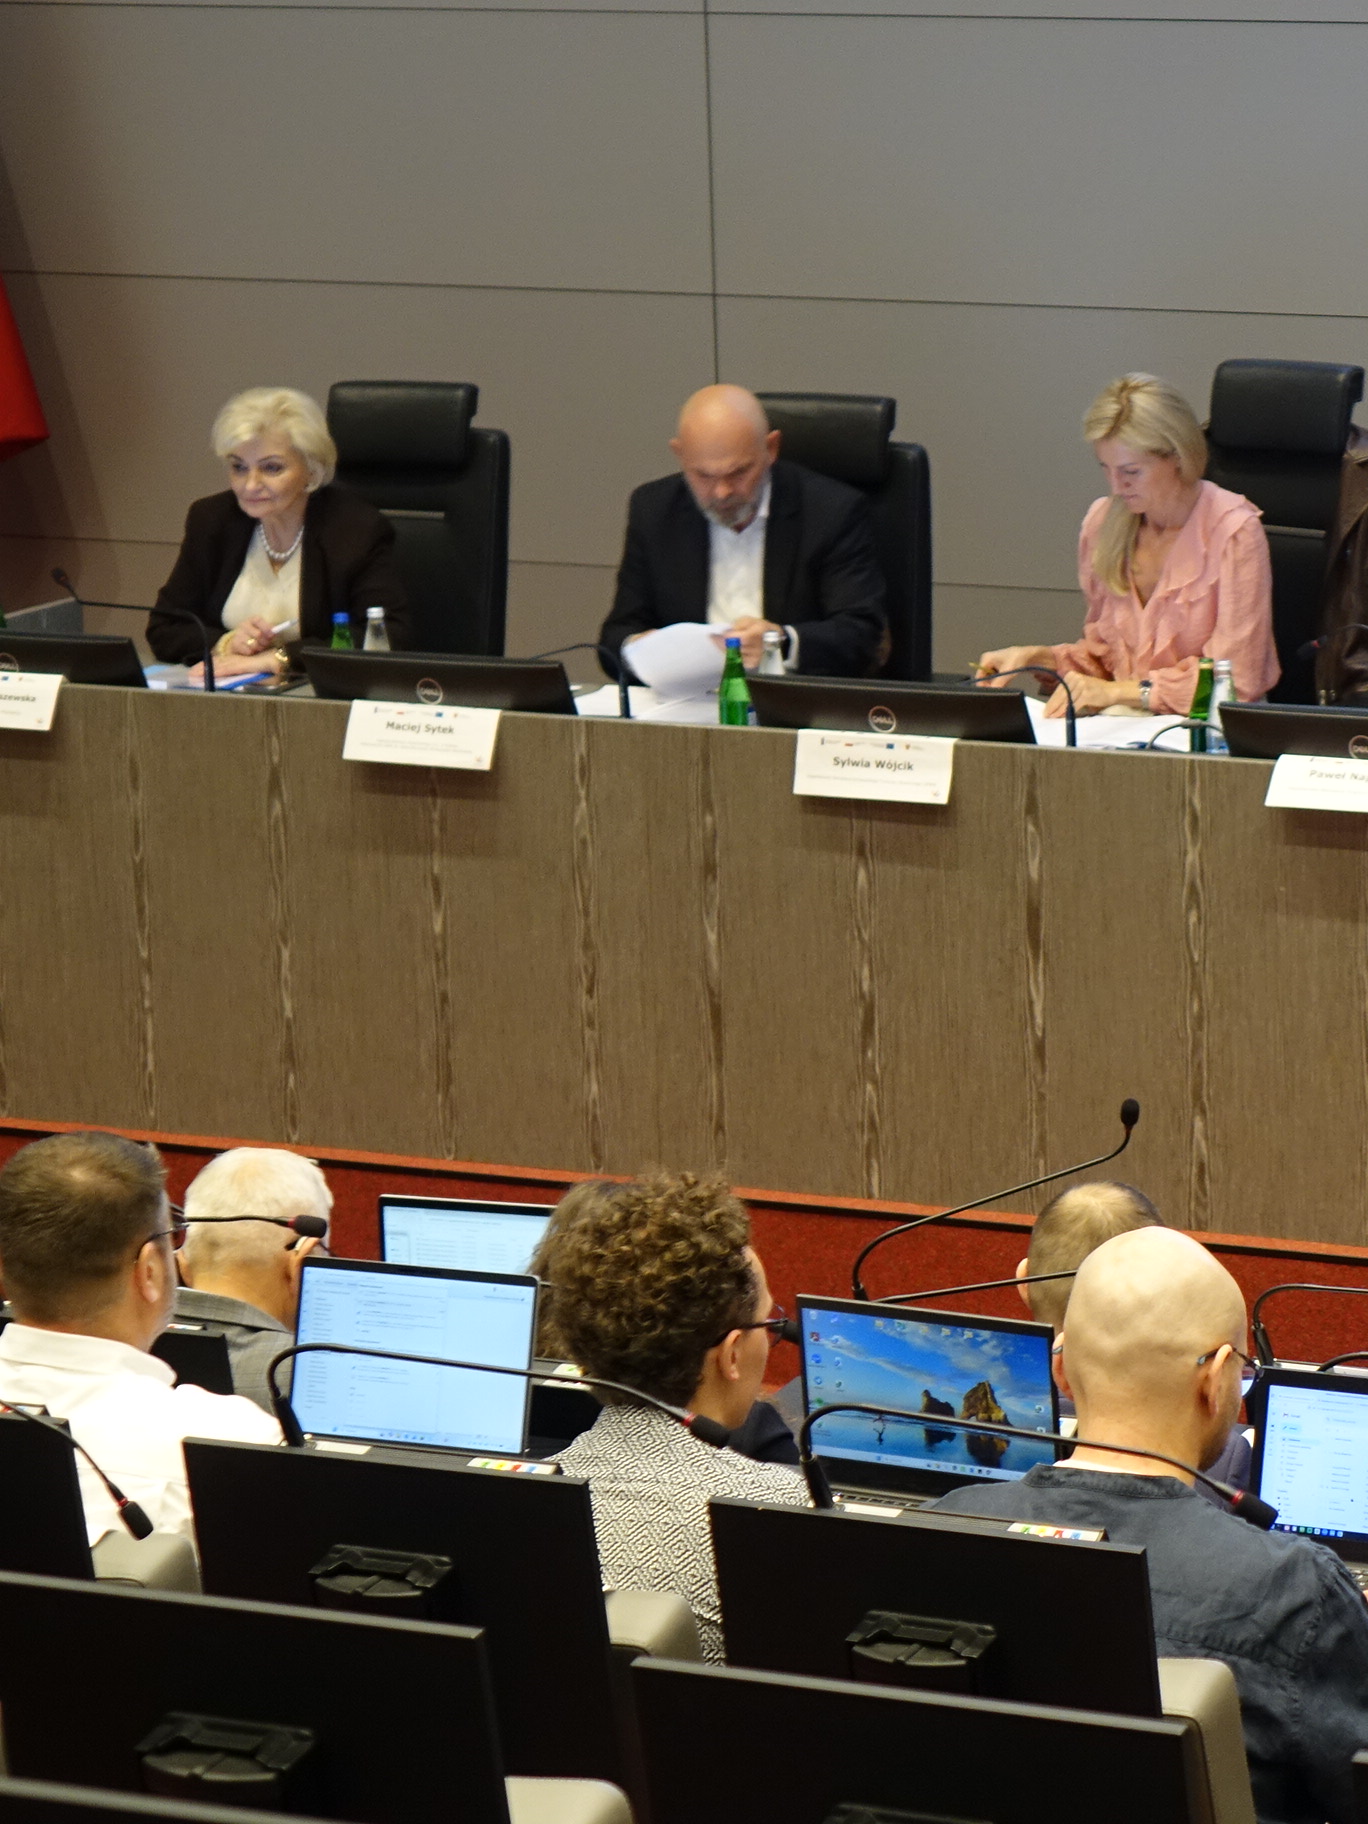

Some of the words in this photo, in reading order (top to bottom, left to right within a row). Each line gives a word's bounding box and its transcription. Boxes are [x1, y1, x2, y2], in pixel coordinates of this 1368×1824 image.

[386, 721, 421, 733] Maciej
[425, 725, 454, 734] Sytek
[833, 756, 871, 768] Sylwia
[875, 760, 914, 772] Wójcik
